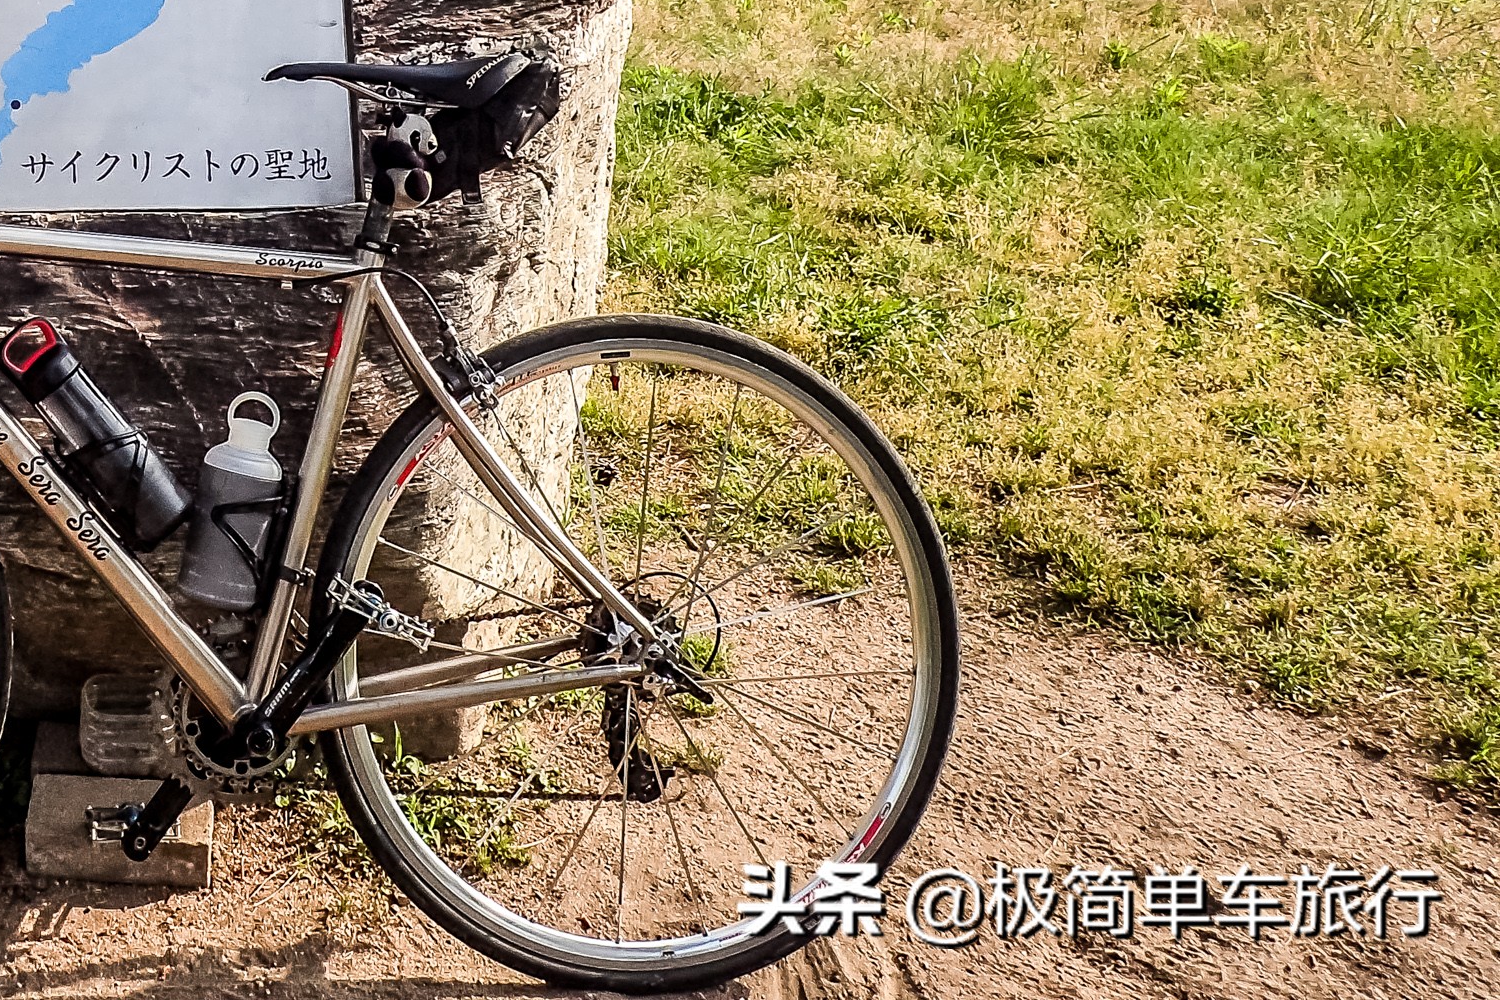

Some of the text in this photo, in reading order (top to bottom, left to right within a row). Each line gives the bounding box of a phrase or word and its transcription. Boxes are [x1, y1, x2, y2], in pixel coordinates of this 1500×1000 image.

[20, 148, 333, 185] サイクリストの聖地
[255, 252, 324, 272] Scorpio
[17, 456, 61, 505] Sera
[66, 511, 110, 560] Sera
[264, 681, 291, 717] SRAM
